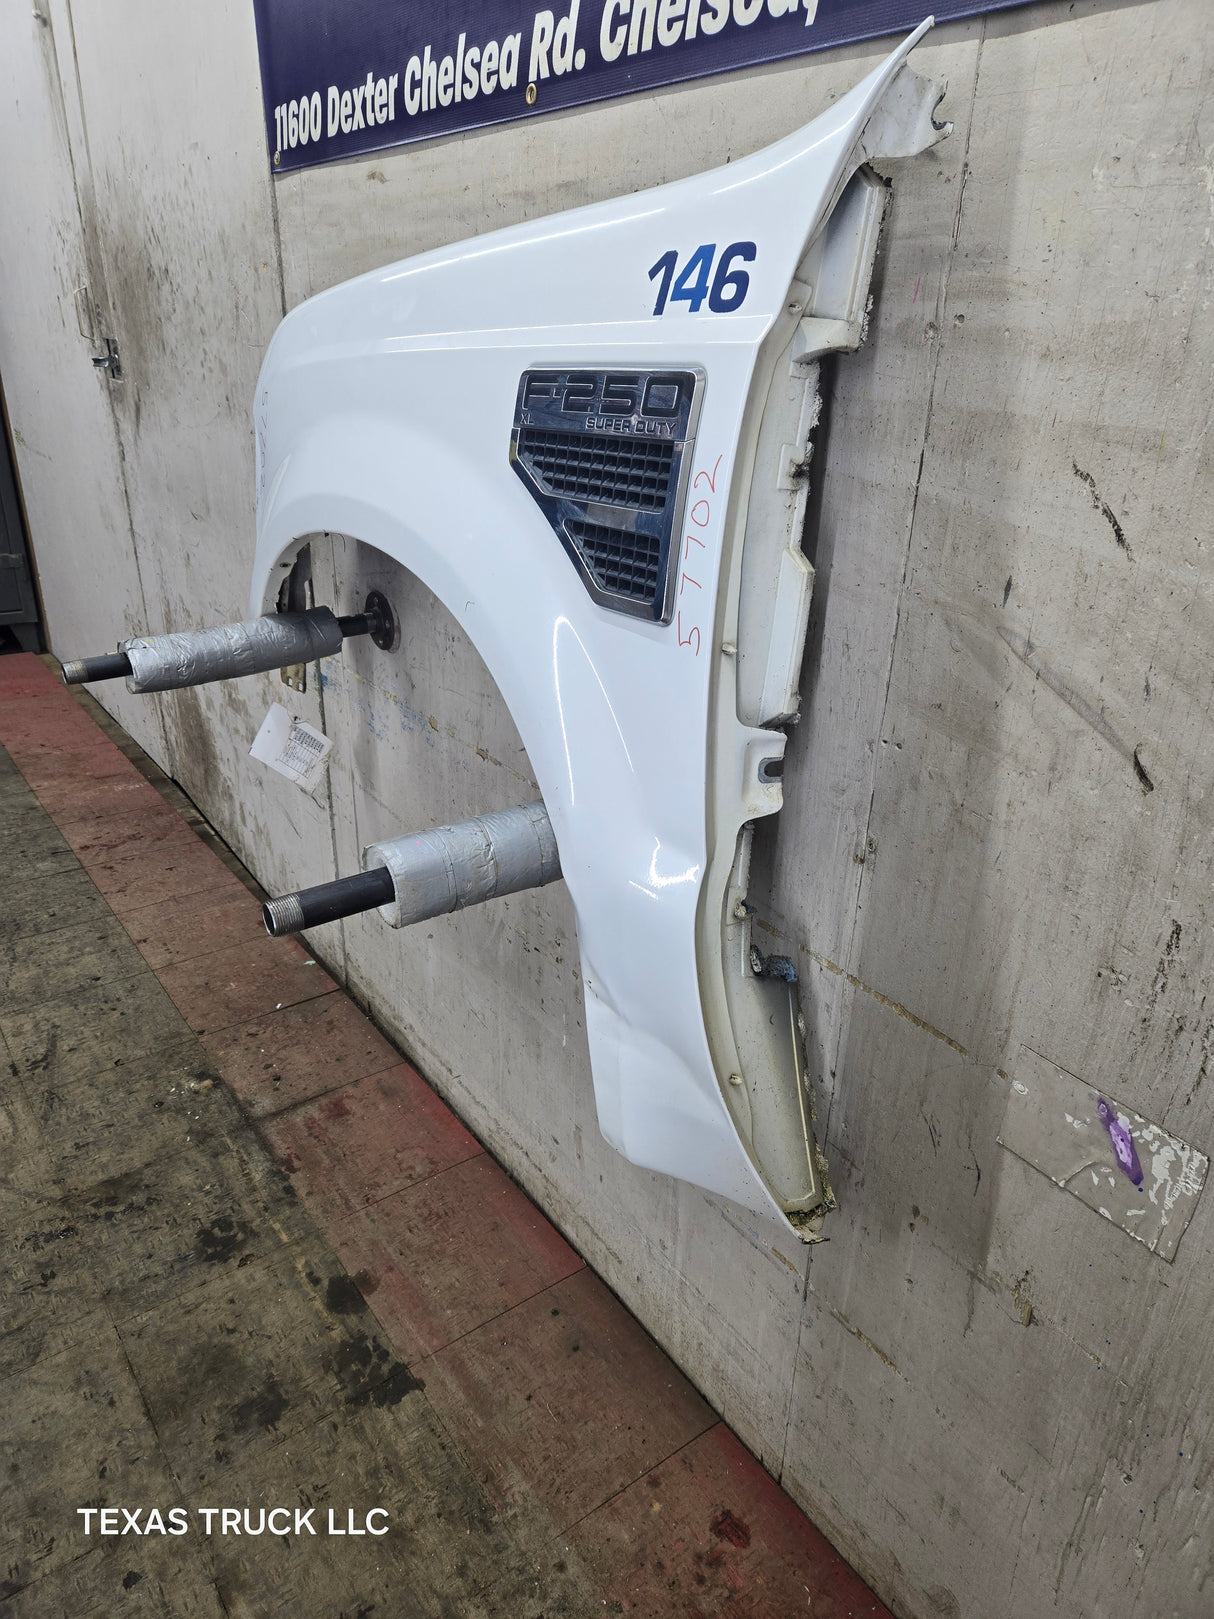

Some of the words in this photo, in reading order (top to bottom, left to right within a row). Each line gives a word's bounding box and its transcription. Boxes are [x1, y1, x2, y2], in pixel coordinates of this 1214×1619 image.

[274, 92, 321, 151] 11600
[327, 72, 398, 138] Dexter
[404, 32, 522, 116] Chelsea
[528, 0, 586, 83] Rd.
[648, 241, 757, 316] 146
[521, 374, 682, 417] F-250
[519, 413, 535, 425] XL
[585, 416, 631, 432] SUPER
[634, 419, 677, 436] DUTY
